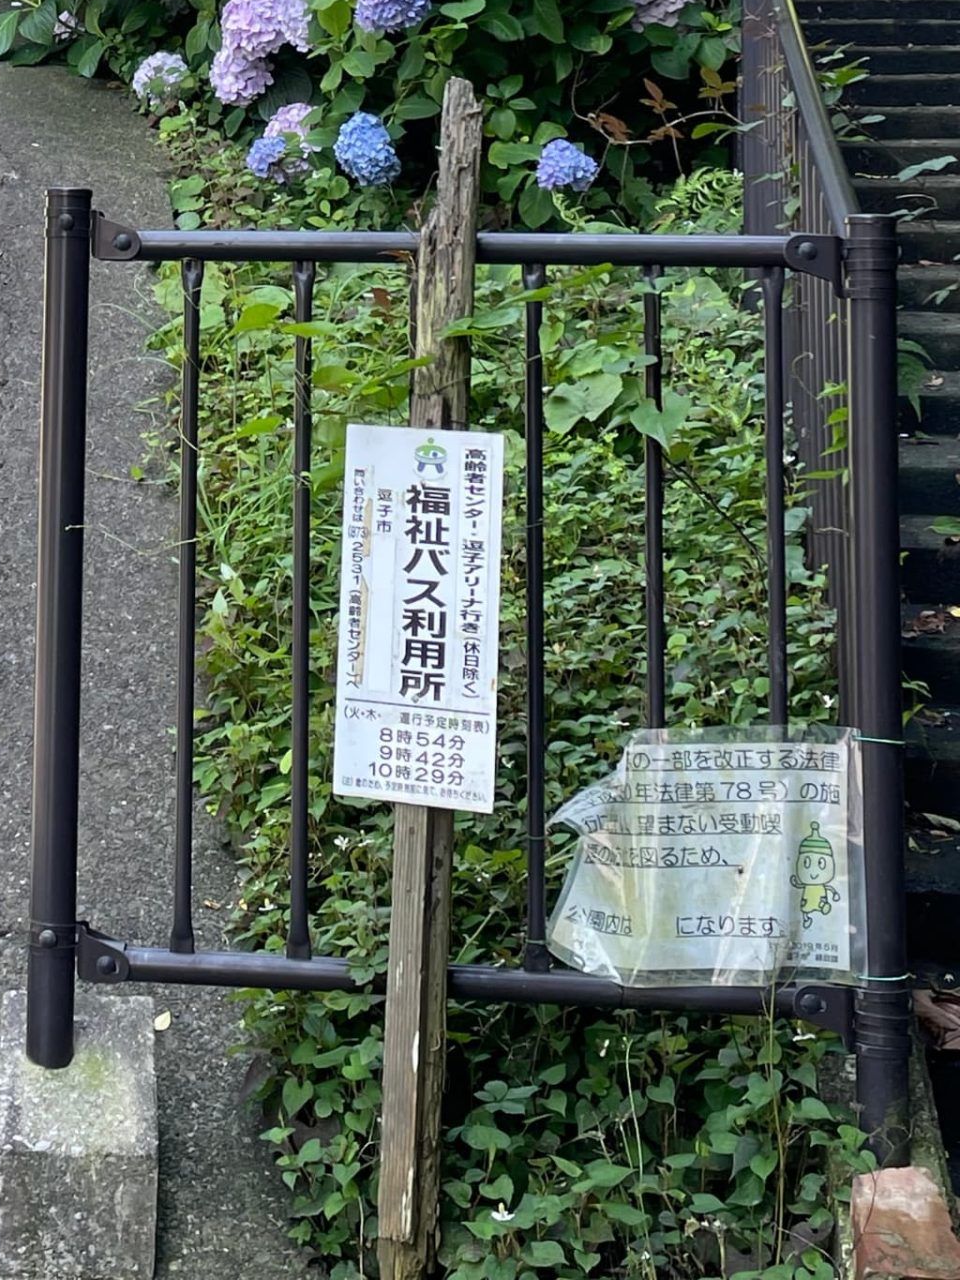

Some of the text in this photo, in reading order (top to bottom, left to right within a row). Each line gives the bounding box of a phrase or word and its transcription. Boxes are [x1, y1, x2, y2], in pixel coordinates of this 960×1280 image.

[376, 488, 393, 533] 逗子市
[399, 484, 451, 702] 福祉バス利用所
[380, 727, 466, 751] 8時54分
[379, 745, 465, 768] 9時42分
[627, 749, 840, 770] の一部を改正する法律
[368, 761, 465, 786] 10時29分
